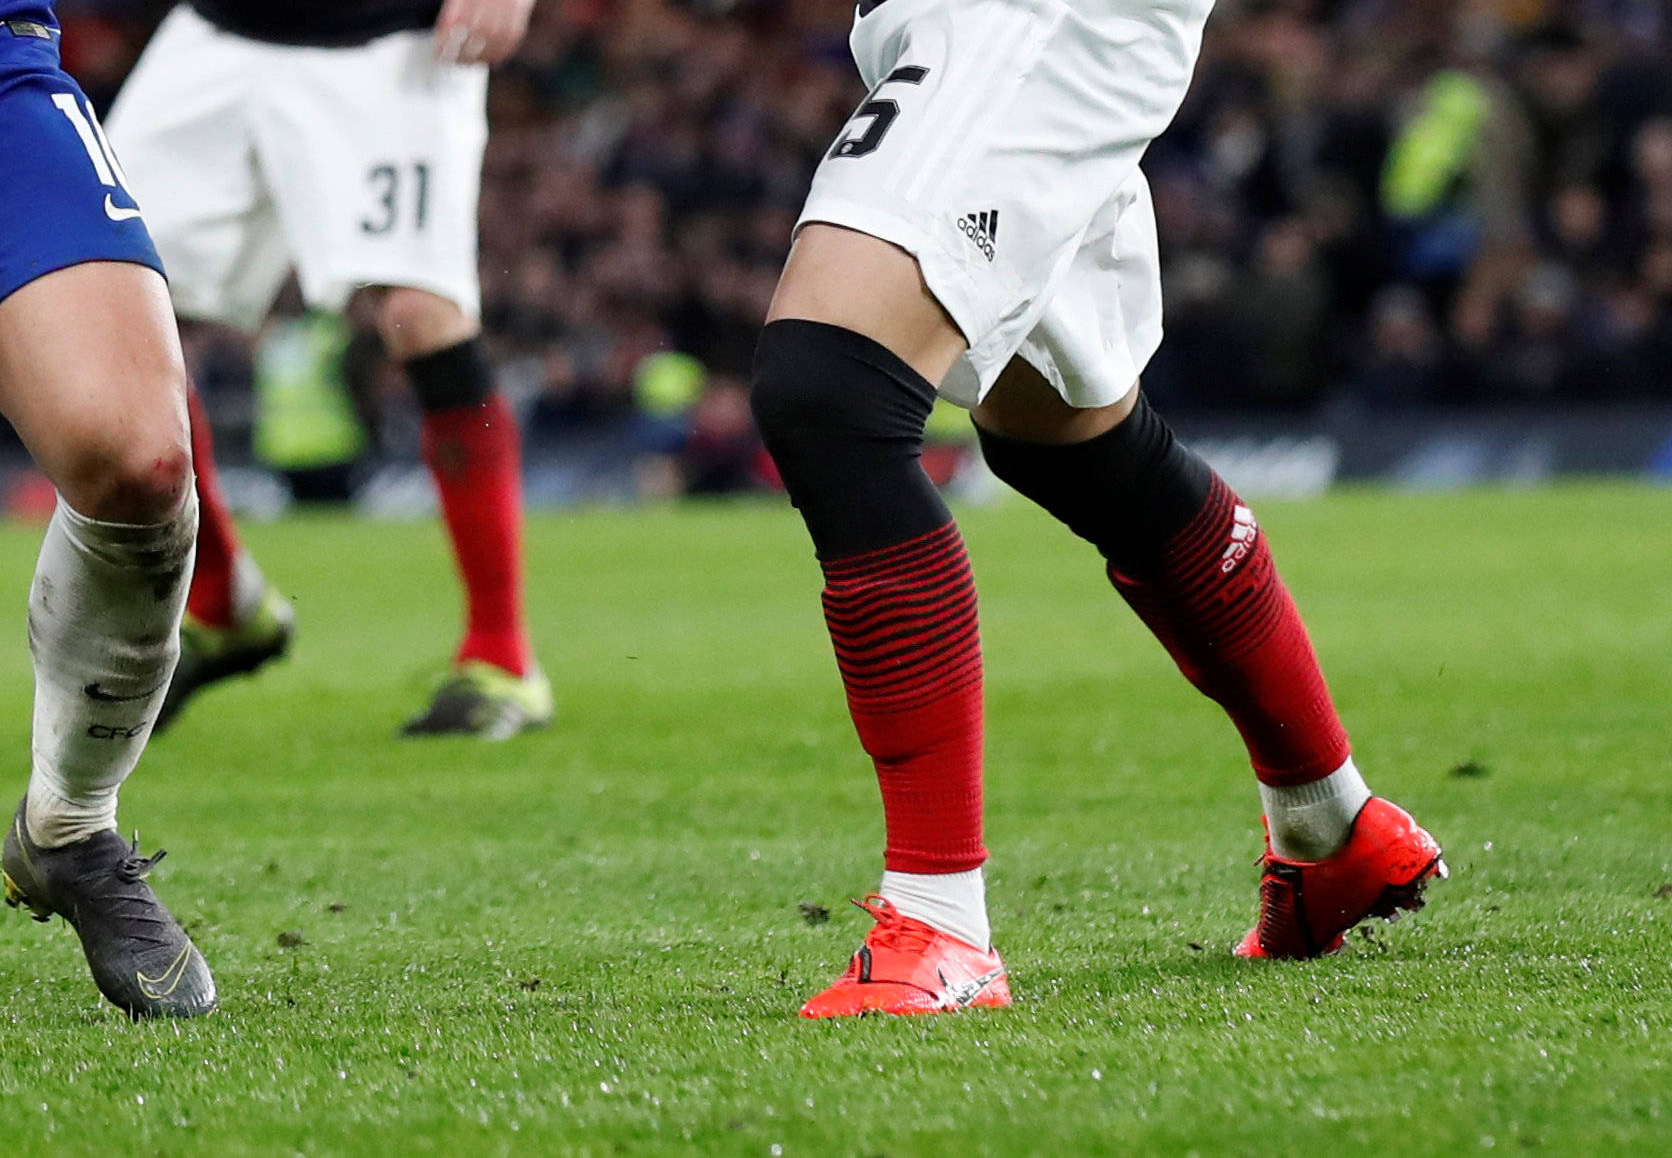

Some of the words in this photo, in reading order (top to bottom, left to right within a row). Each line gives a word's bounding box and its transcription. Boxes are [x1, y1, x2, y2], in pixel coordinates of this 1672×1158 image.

[360, 162, 430, 236] 31
[956, 217, 996, 263] adidas
[87, 720, 148, 740] CFC
